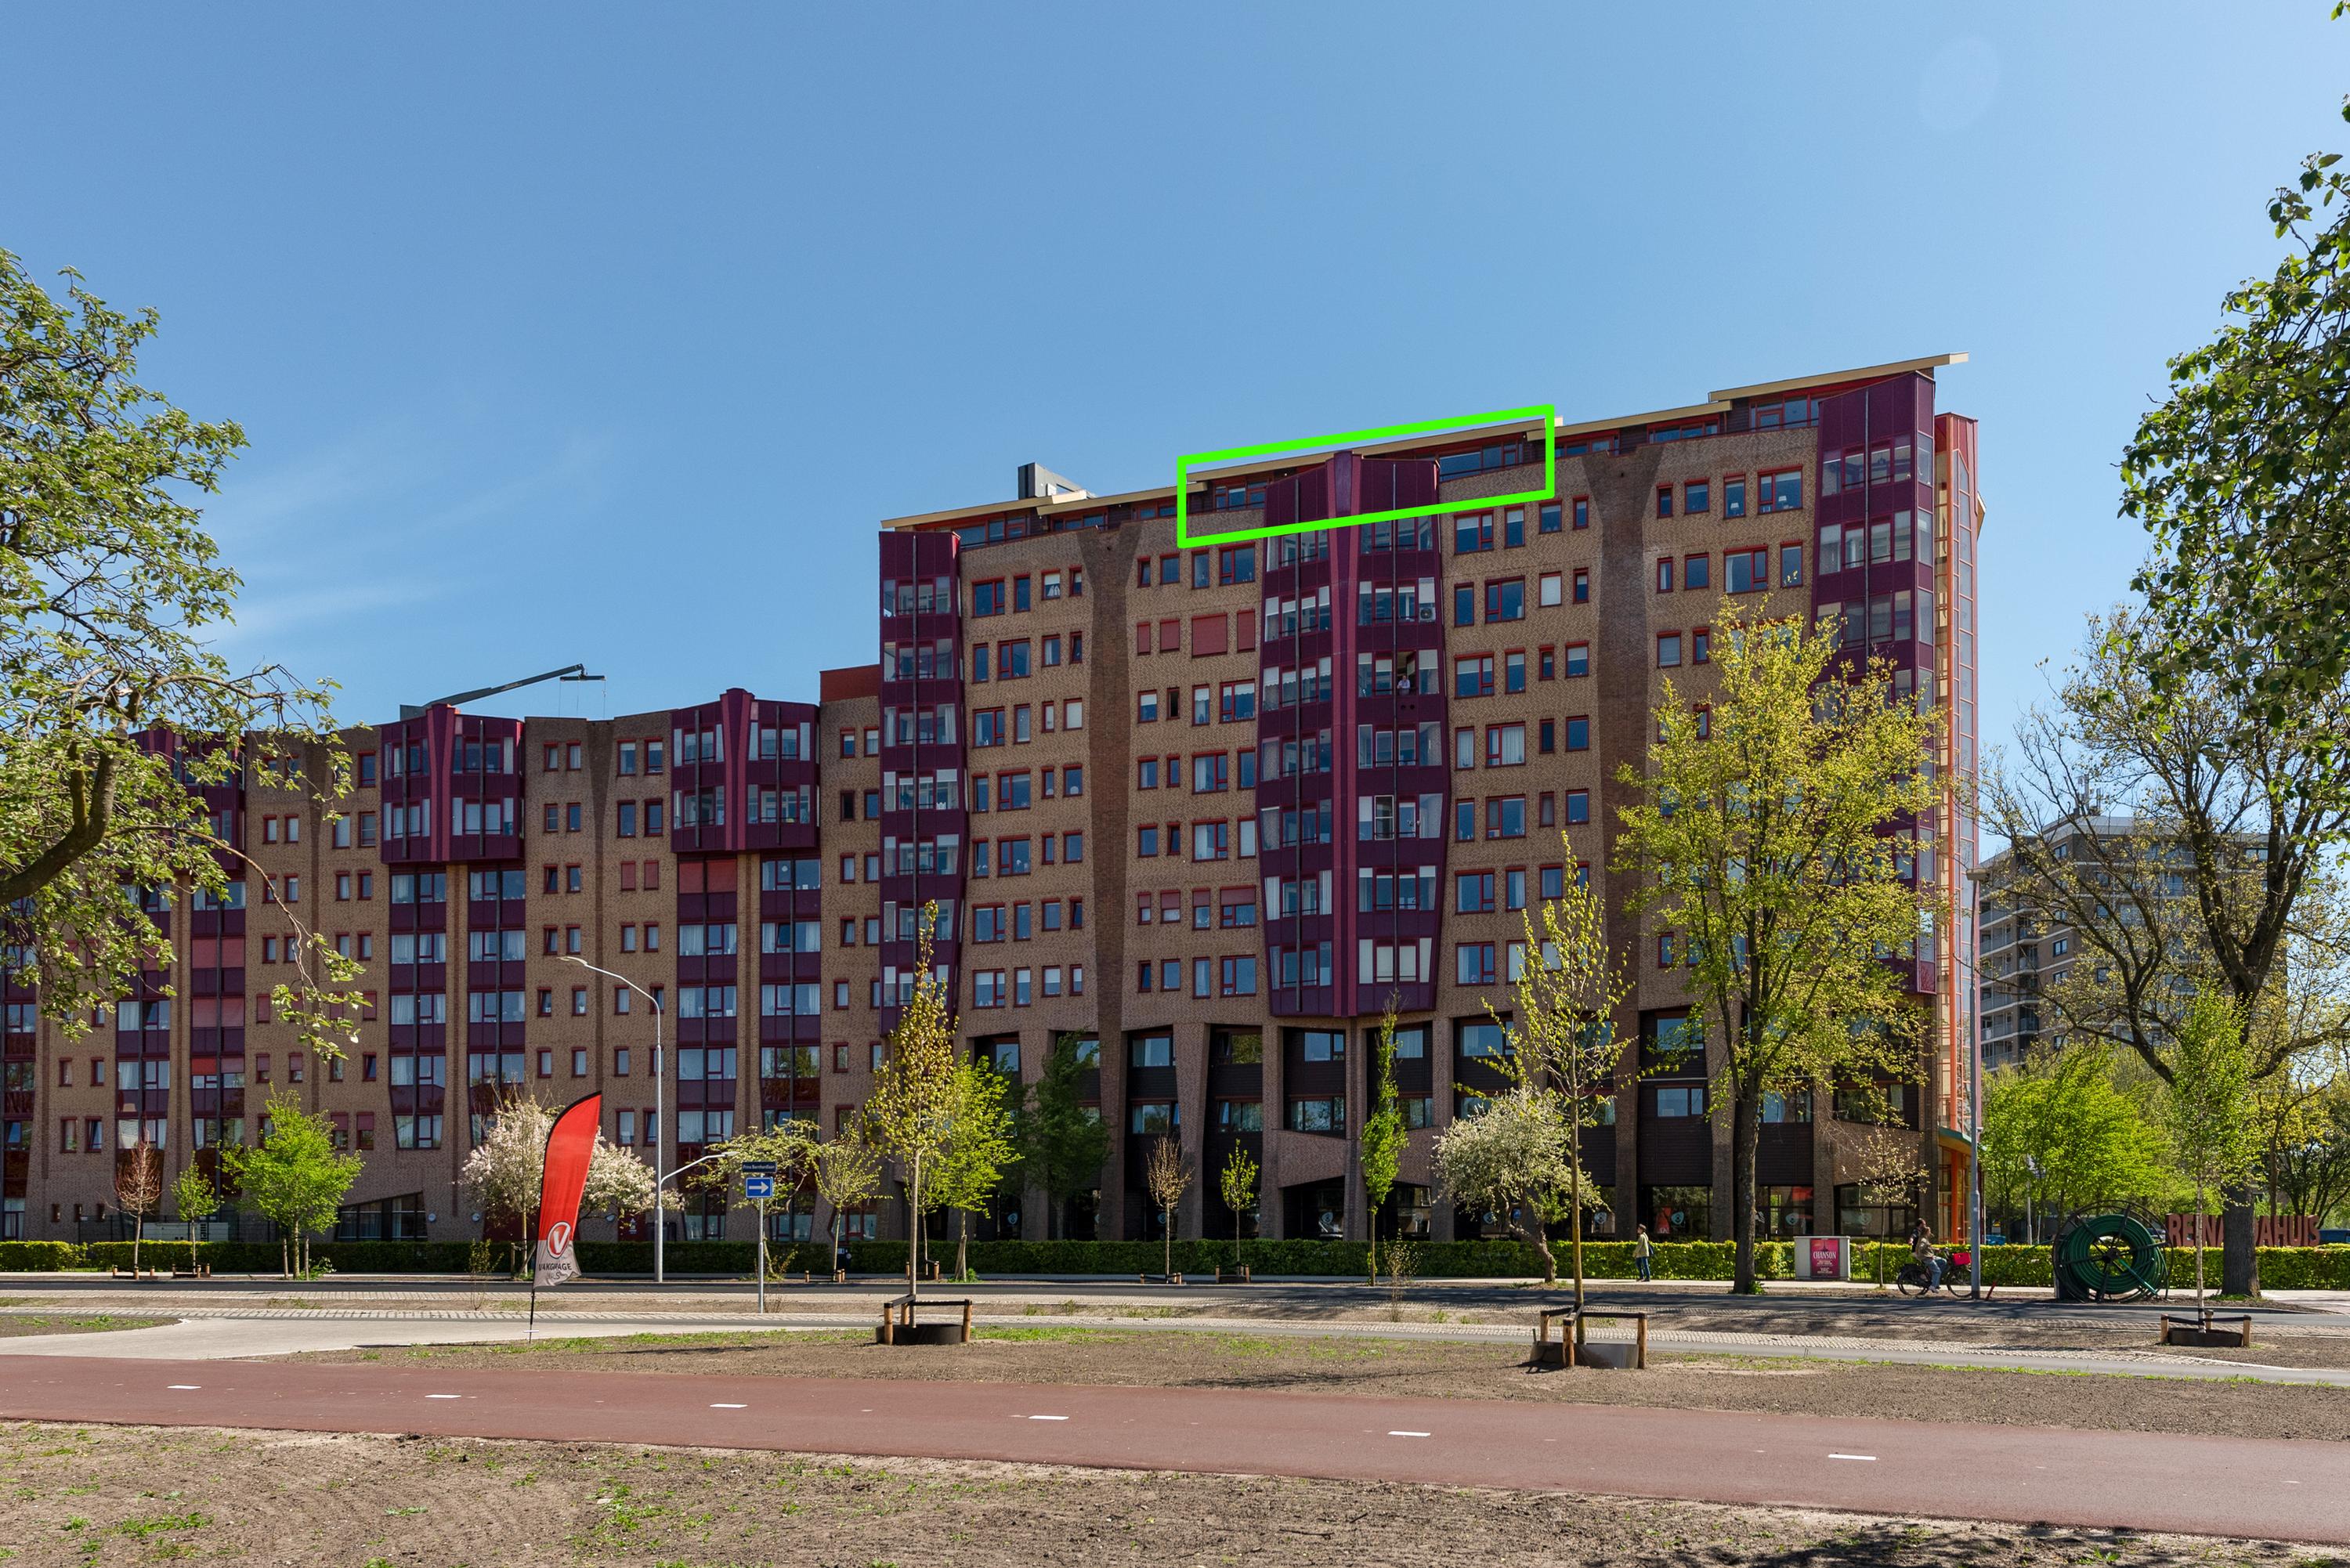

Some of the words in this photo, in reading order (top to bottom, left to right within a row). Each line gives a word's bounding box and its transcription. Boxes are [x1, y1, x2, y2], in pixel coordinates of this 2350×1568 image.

[2165, 1213, 2320, 1248] RENAAHUIS
[1813, 1251, 1837, 1259] CHANSON
[538, 1263, 572, 1271] VAKGAGE
